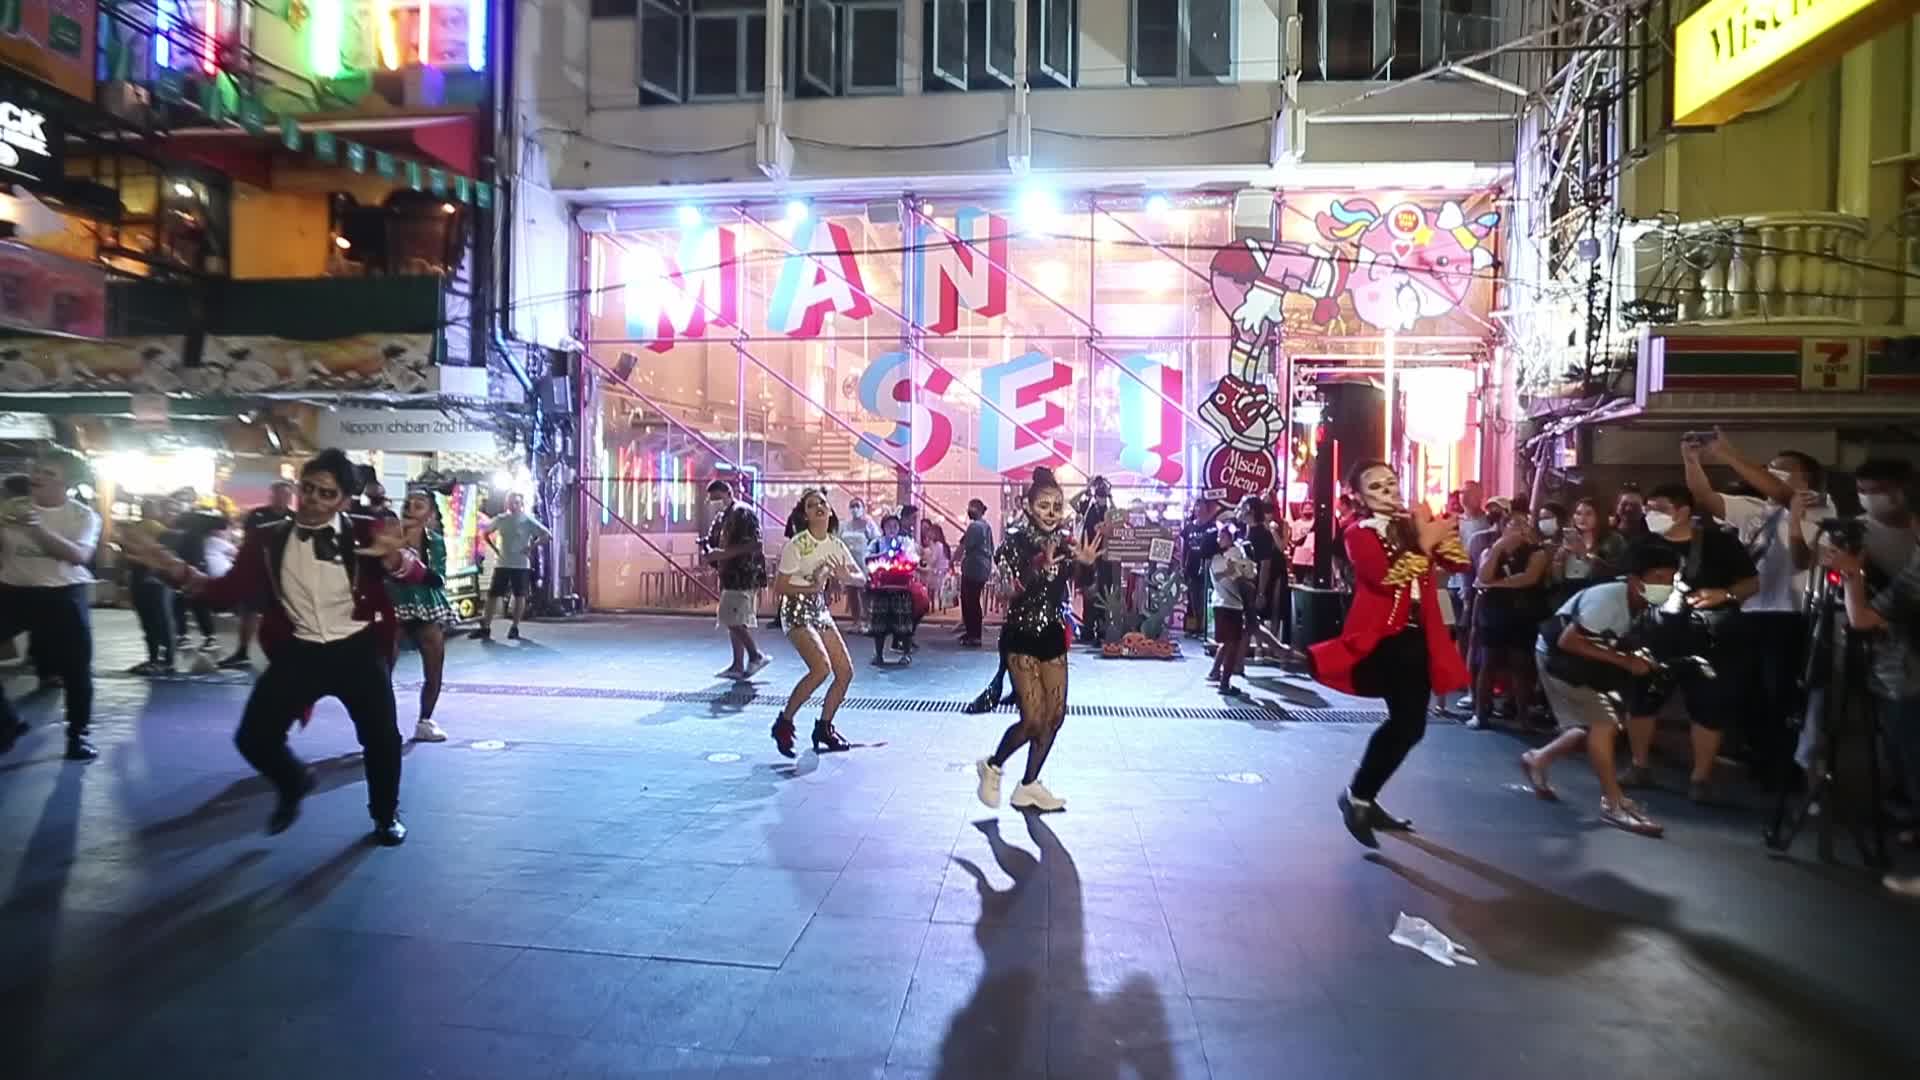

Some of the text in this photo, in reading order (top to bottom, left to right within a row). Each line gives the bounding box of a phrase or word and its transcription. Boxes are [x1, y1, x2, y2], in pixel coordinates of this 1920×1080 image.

[622, 205, 1008, 354] MAN
[339, 420, 383, 435] Nippon
[433, 420, 456, 434] 2nd
[1223, 449, 1267, 477] Mischa
[1219, 465, 1260, 494] Cheap
